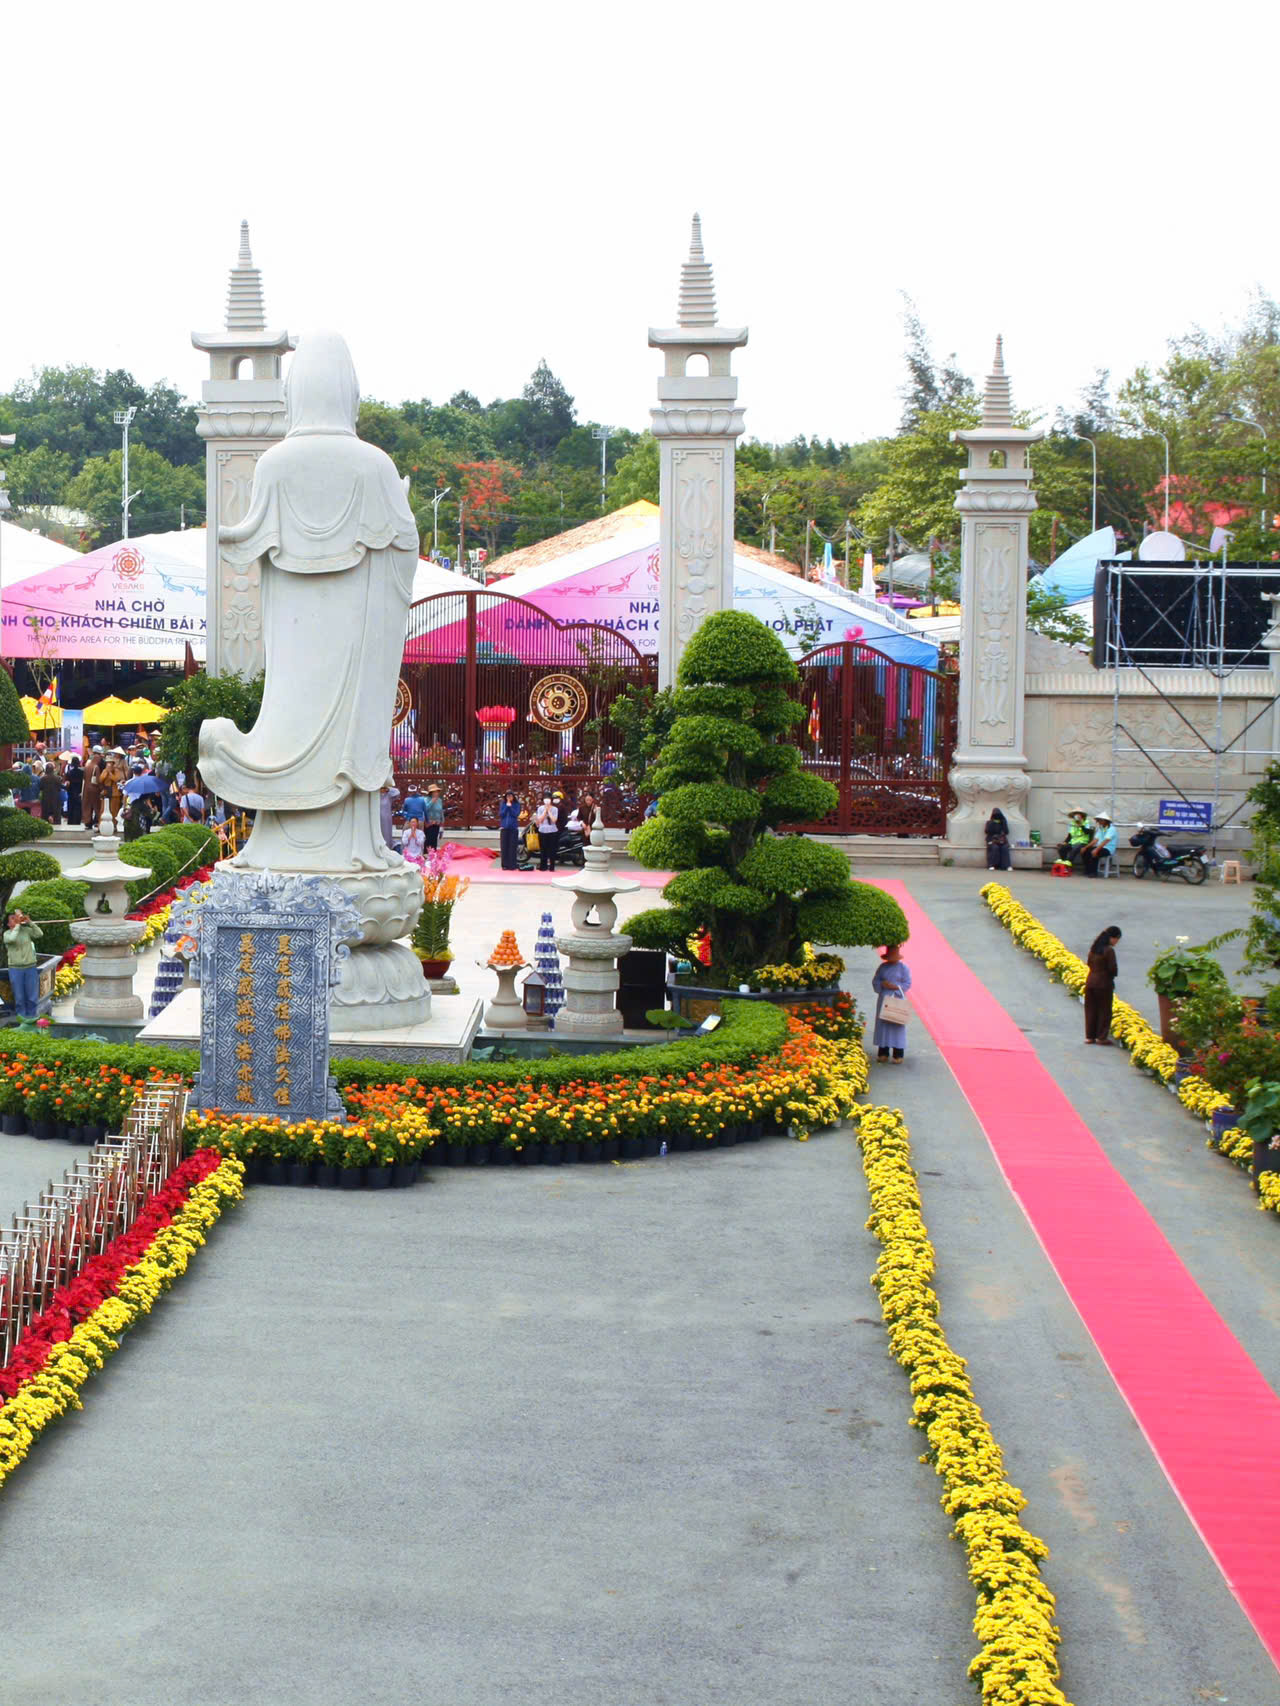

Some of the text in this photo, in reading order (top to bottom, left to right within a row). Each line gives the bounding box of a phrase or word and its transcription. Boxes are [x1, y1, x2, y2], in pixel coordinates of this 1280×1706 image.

[95, 597, 165, 612] NHÀ CHỜ
[630, 598, 659, 613] NHÀ
[1, 615, 18, 627] NH
[22, 615, 56, 628] CHO
[61, 613, 113, 628] KHÁCH
[119, 615, 165, 629] CHIÊM
[594, 616, 649, 631] KHÁCH
[42, 635, 77, 643] WAITING
[80, 635, 102, 643] AREA
[104, 636, 120, 644] FOR
[123, 636, 136, 644] THE
[138, 636, 174, 645] BUDDHA
[638, 638, 656, 647] FOR
